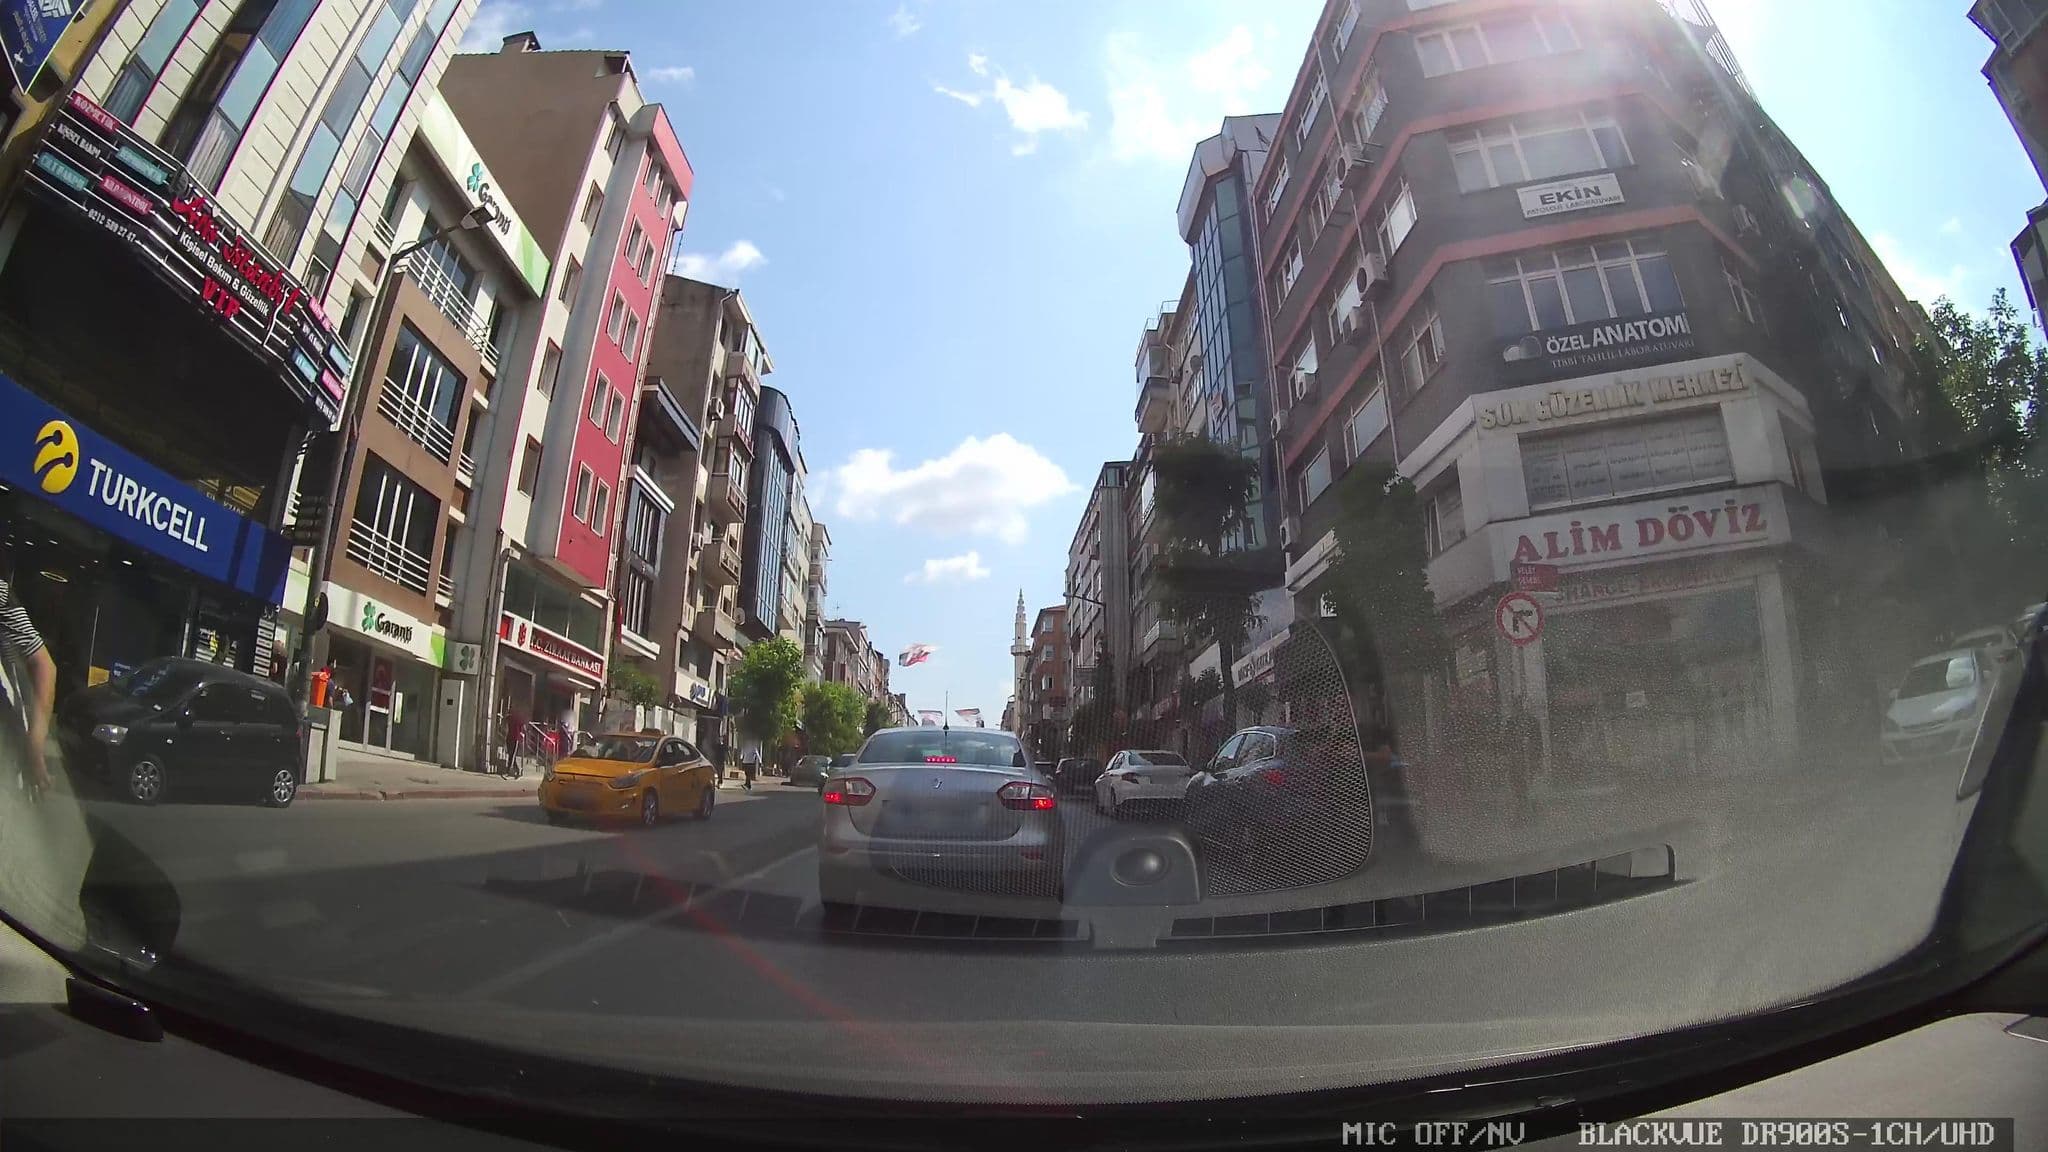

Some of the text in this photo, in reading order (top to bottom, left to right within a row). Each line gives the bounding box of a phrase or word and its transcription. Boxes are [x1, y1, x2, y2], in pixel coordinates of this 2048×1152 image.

[1539, 185, 1603, 206] EKİN
[179, 232, 269, 318] Kişisel Bakım & Güzellik
[202, 275, 242, 321] VIP
[1546, 334, 1591, 355] ÖZEL
[88, 457, 208, 553] TURKCELL
[1514, 498, 1768, 563] ALİM DÖVİZ
[375, 612, 413, 645] Garanti
